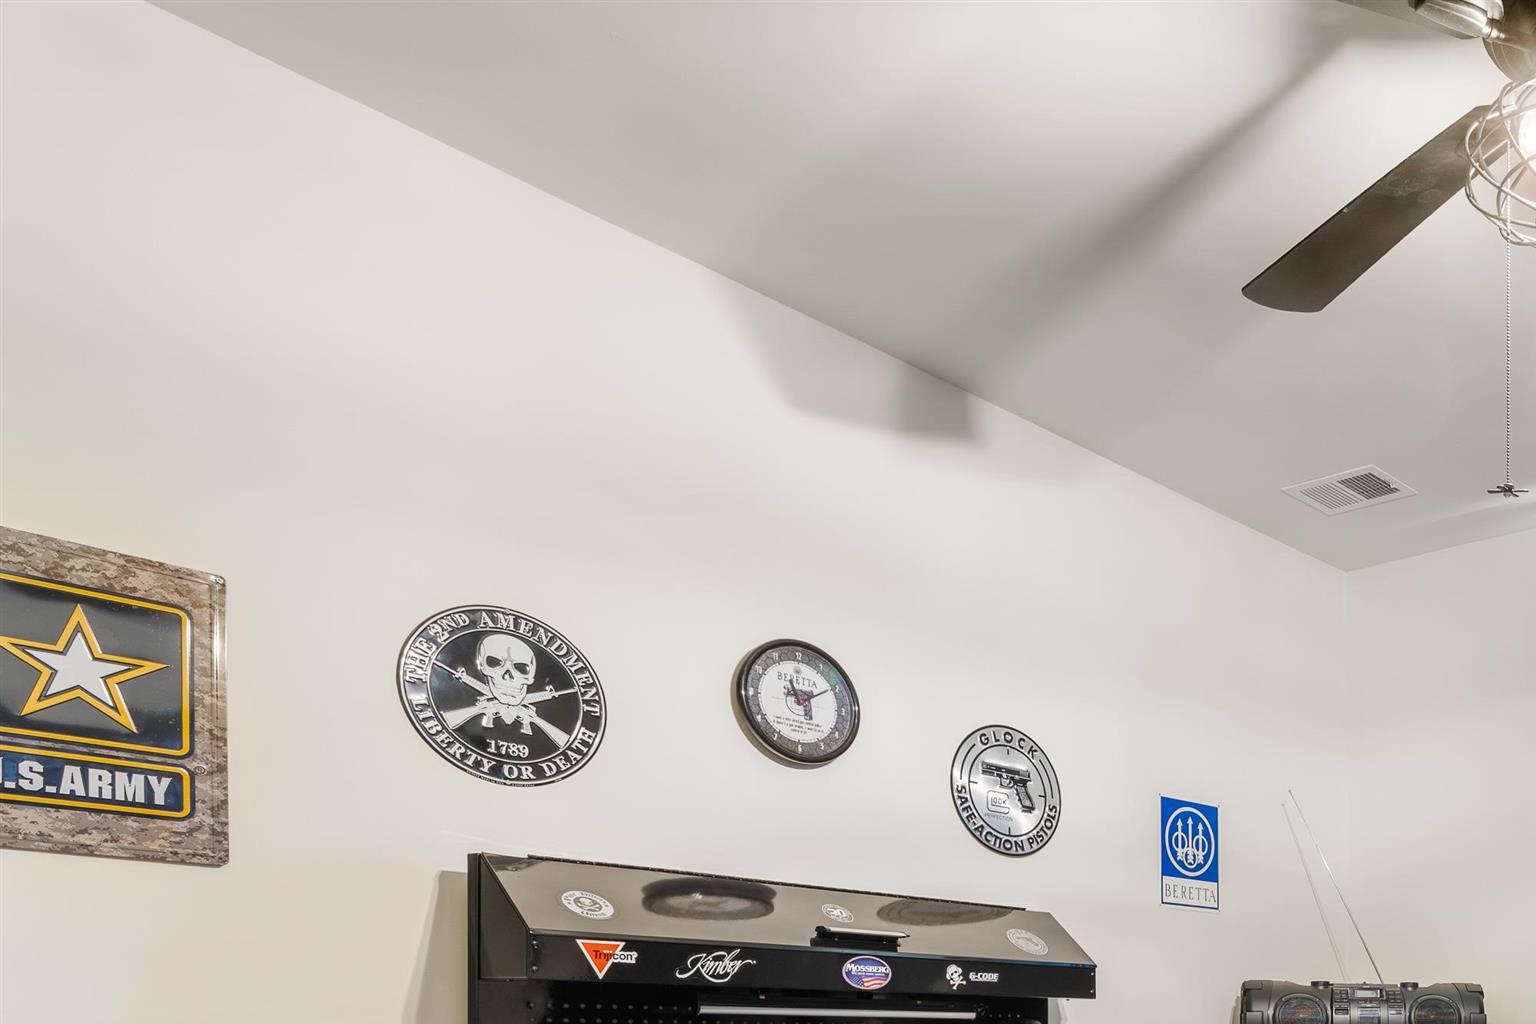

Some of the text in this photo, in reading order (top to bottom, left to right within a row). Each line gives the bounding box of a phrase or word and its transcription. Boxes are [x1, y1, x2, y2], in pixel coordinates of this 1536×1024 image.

[404, 611, 601, 717] THE 2ND AMENDMENT
[413, 697, 596, 780] LIBERTY OR DEATH
[487, 739, 529, 758] 1789
[979, 730, 1039, 760] GLOCK
[956, 784, 1058, 852] SAFE-ACTION PISTOLS
[1165, 883, 1217, 903] BERETTA
[592, 950, 633, 962] Trijicon
[676, 949, 756, 983] Kimber
[969, 972, 999, 981] G-CODE
